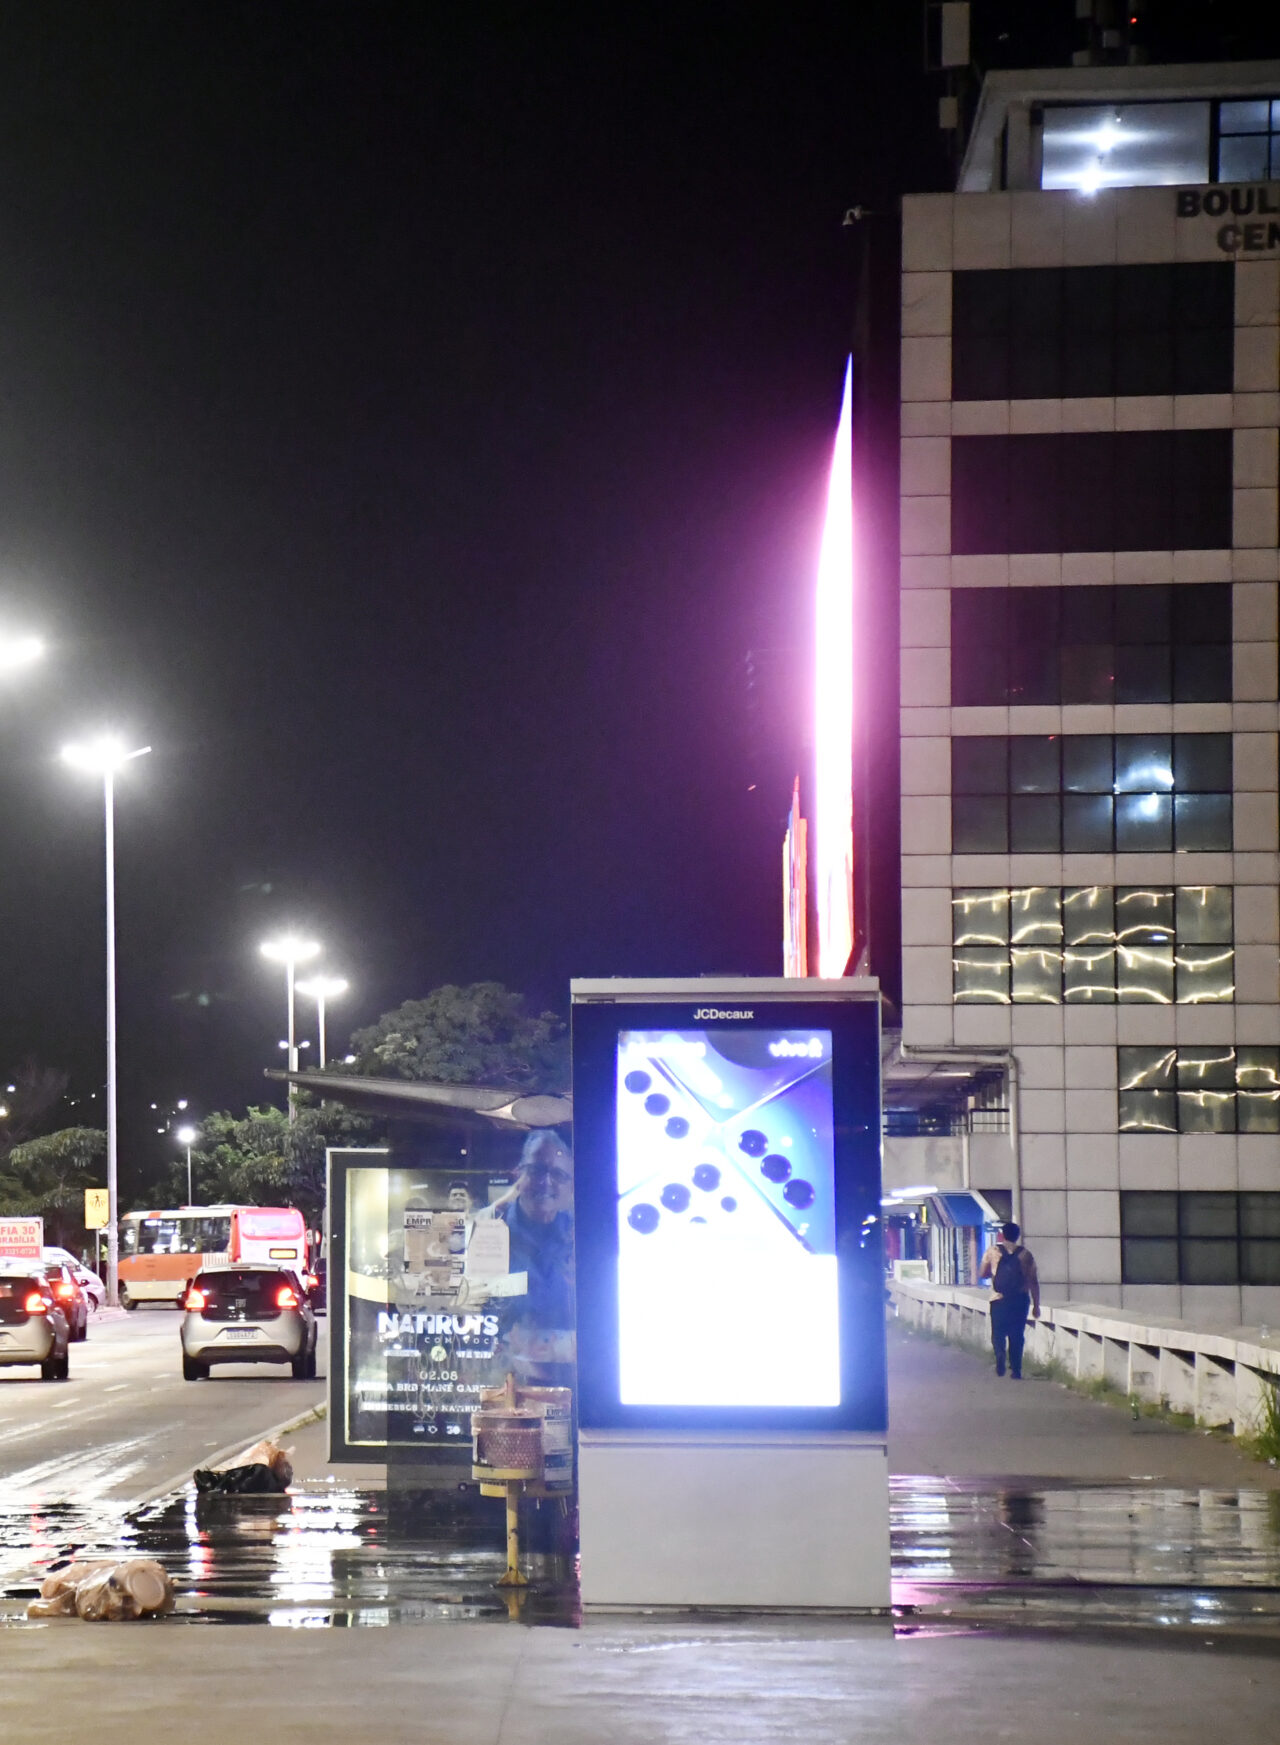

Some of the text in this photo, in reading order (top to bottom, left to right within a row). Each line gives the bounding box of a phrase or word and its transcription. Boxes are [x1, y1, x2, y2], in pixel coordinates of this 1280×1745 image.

[1177, 187, 1280, 217] BOUL
[694, 1009, 754, 1020] JCDecaux
[22, 1226, 35, 1235] 3D
[378, 1312, 499, 1336] NATIRUTS
[420, 1371, 458, 1381] 02.08
